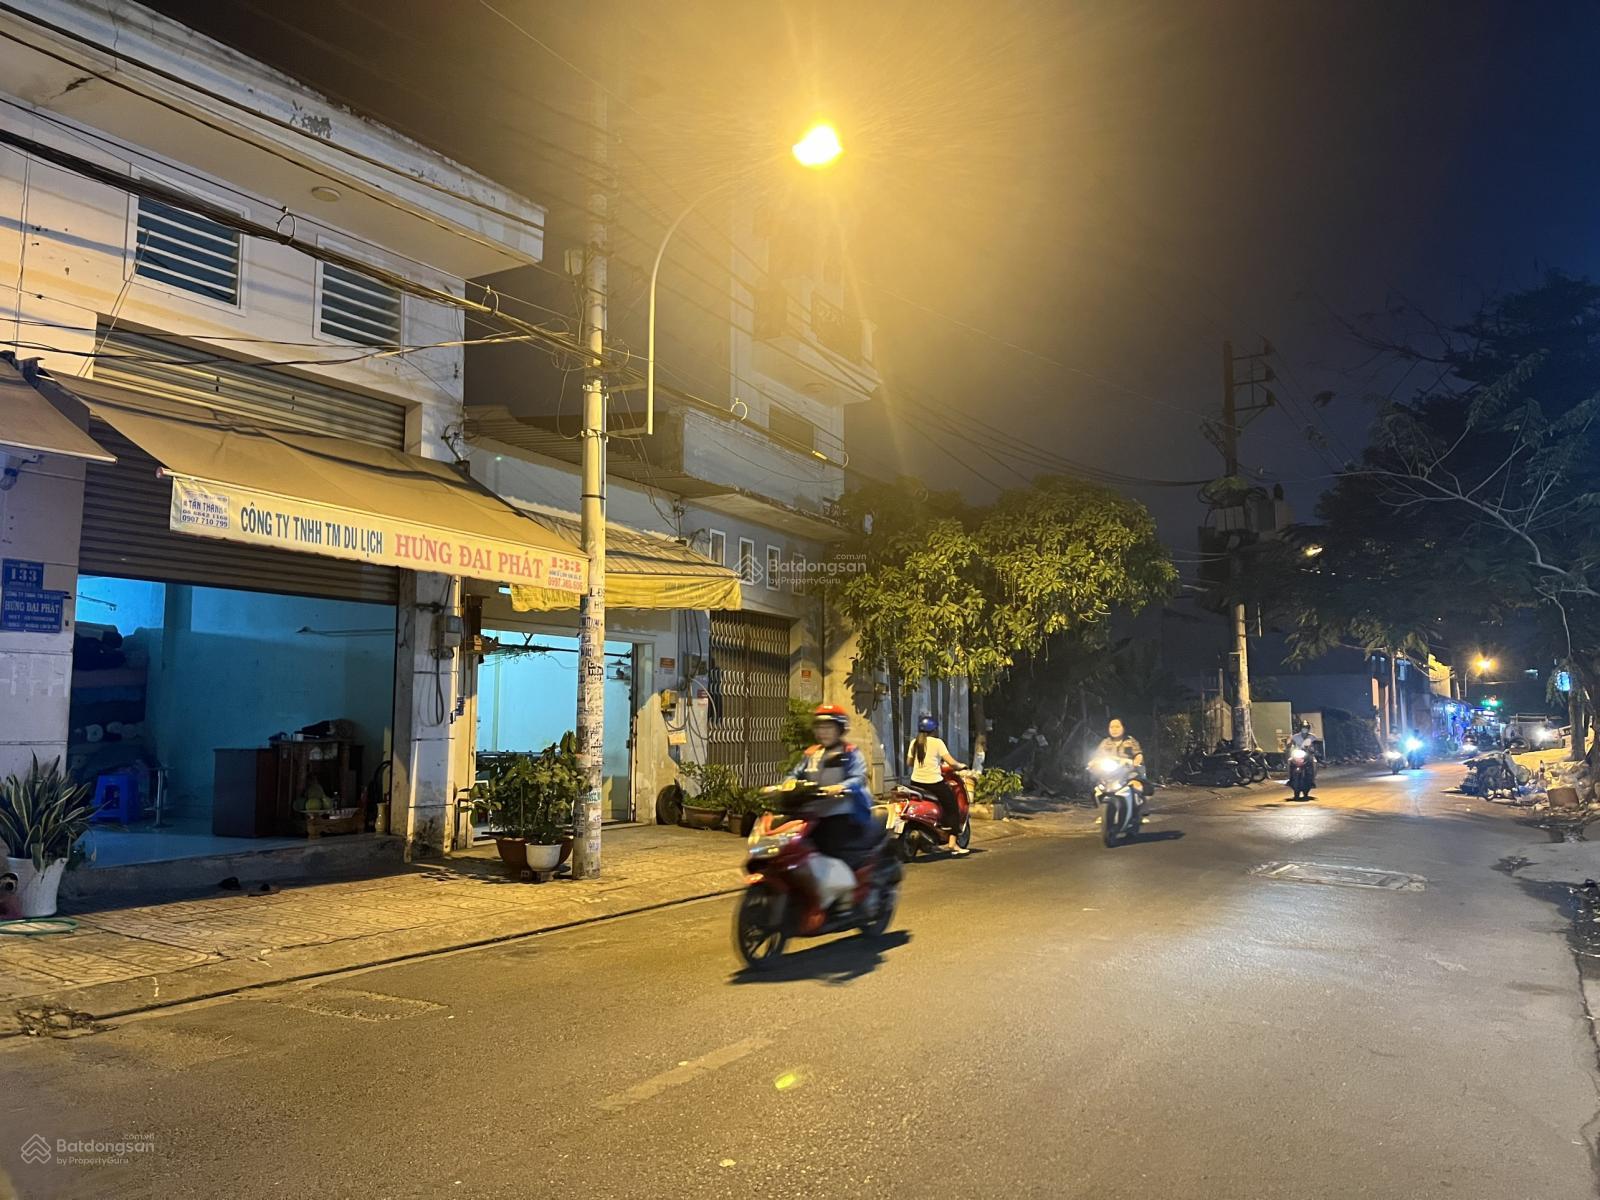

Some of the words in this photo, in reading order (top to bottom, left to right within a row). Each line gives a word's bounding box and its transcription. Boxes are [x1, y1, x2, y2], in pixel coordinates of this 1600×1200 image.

[240, 501, 272, 536] CÔNG
[275, 512, 290, 539] TY
[293, 516, 322, 544] TNHH
[325, 522, 341, 547] TM
[344, 526, 358, 550] DU
[361, 528, 383, 557] LỊCH
[394, 533, 453, 564] HƯNG
[458, 545, 493, 575] ĐẠI
[497, 549, 544, 579] PHÁT
[11, 567, 37, 582] 133
